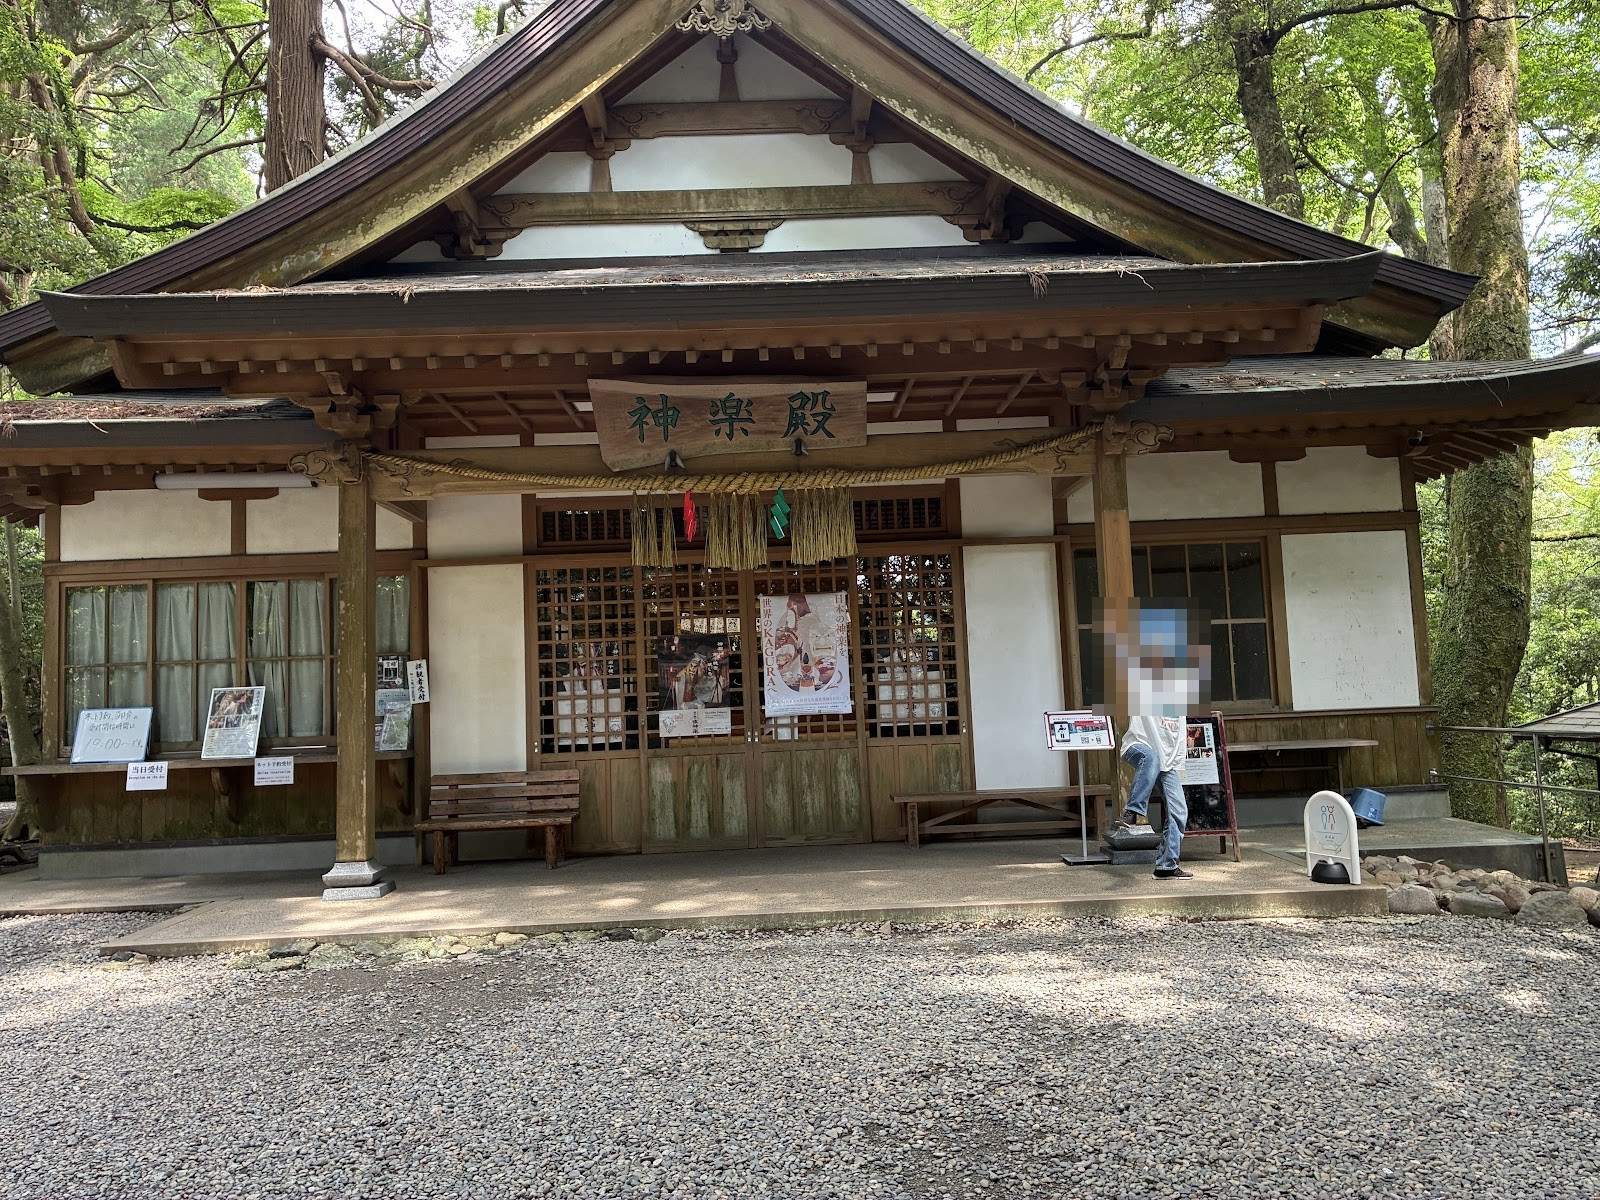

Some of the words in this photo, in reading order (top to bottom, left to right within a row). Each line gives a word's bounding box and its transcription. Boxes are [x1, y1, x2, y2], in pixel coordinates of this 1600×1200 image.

[627, 390, 836, 443] 神楽殿
[762, 598, 778, 693] 世界のKAGURAへ
[132, 765, 164, 774] 当日受付
